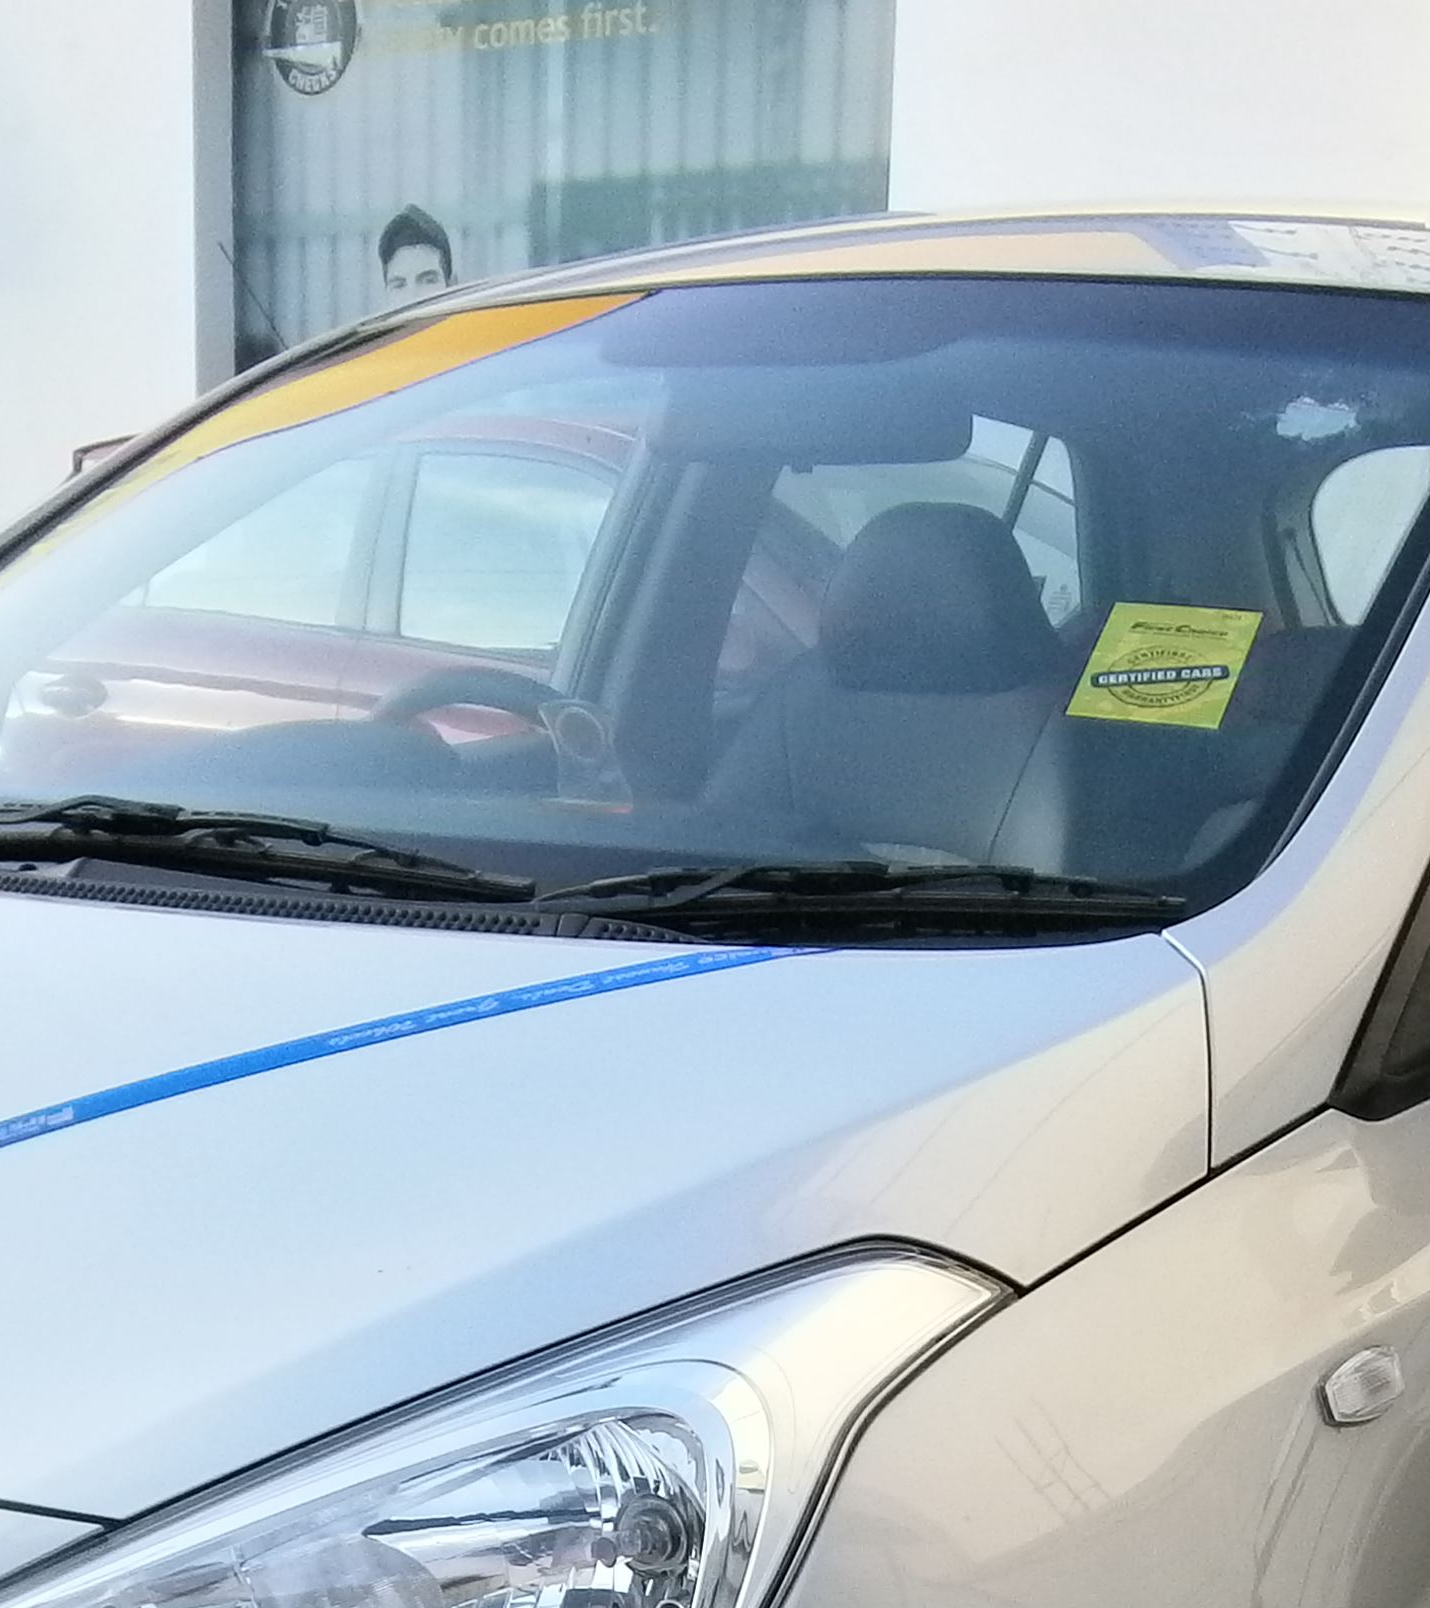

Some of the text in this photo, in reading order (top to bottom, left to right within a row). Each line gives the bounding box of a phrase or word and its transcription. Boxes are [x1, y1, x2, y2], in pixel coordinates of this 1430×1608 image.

[474, 15, 569, 49] comes
[1098, 666, 1222, 684] CERTIFIED CARS
